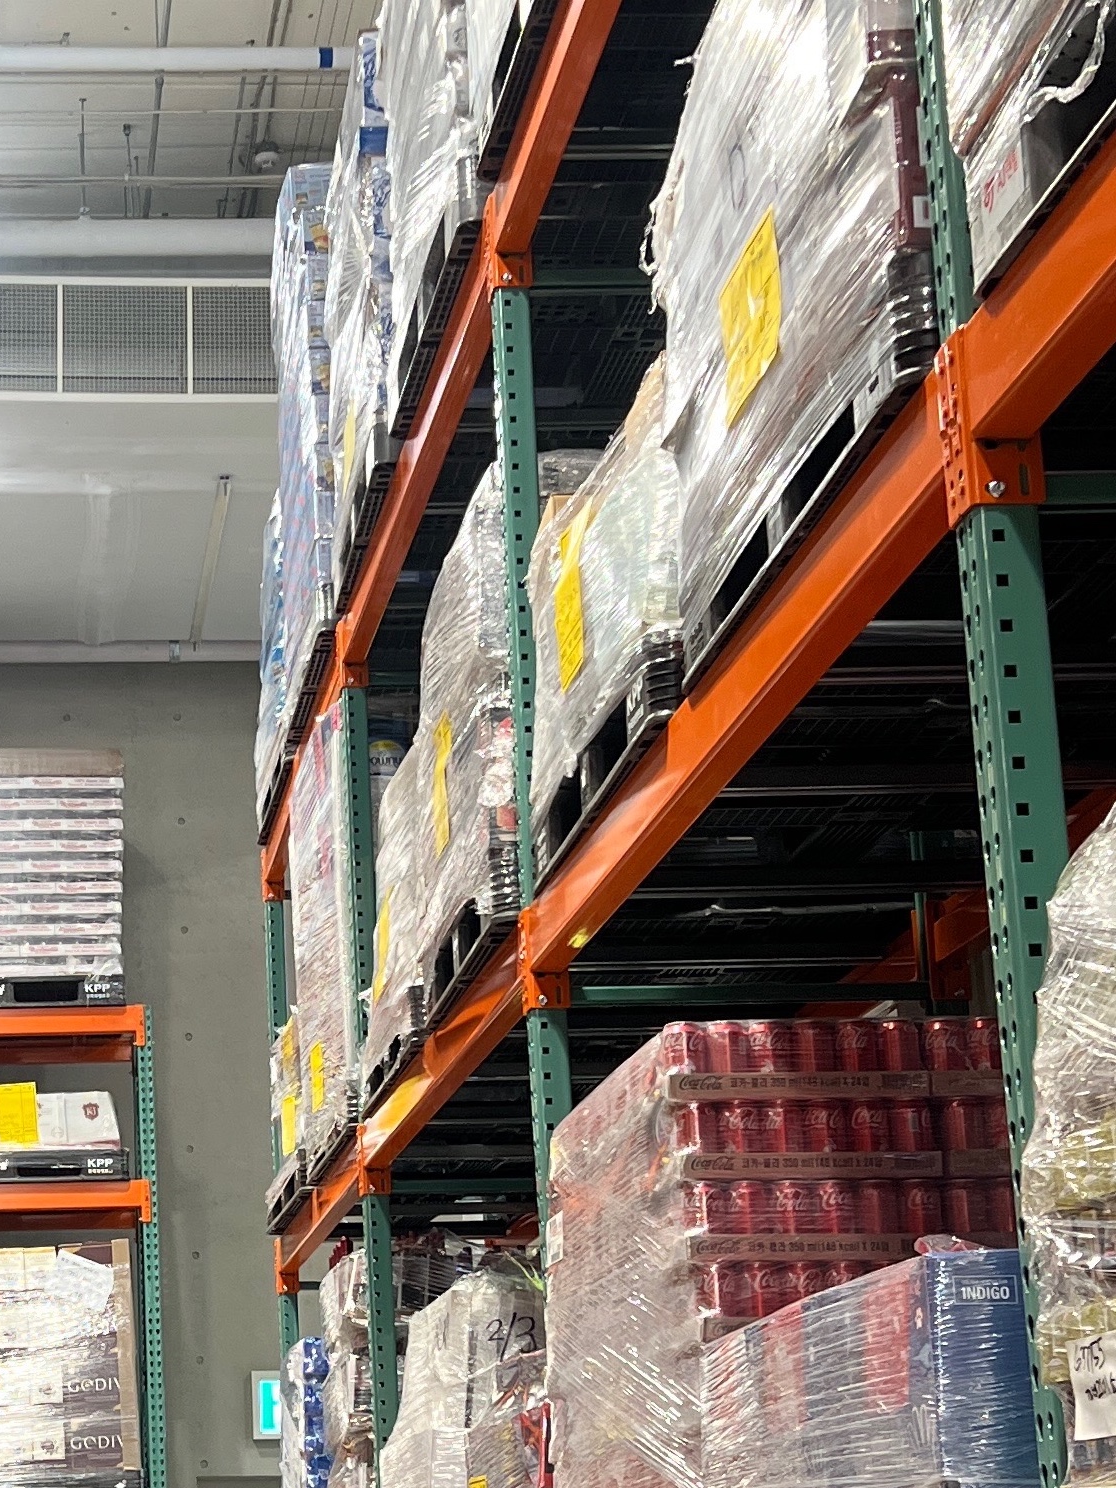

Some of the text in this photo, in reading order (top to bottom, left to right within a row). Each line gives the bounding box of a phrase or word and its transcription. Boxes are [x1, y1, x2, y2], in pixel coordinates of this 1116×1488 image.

[369, 756, 401, 768] owny
[84, 983, 111, 993] KPP
[87, 1158, 114, 1168] KPP
[960, 1285, 1010, 1301] INDIGO
[485, 1311, 538, 1363] 2/3
[67, 1377, 122, 1393] GODIV
[69, 1434, 124, 1451] GODIV
